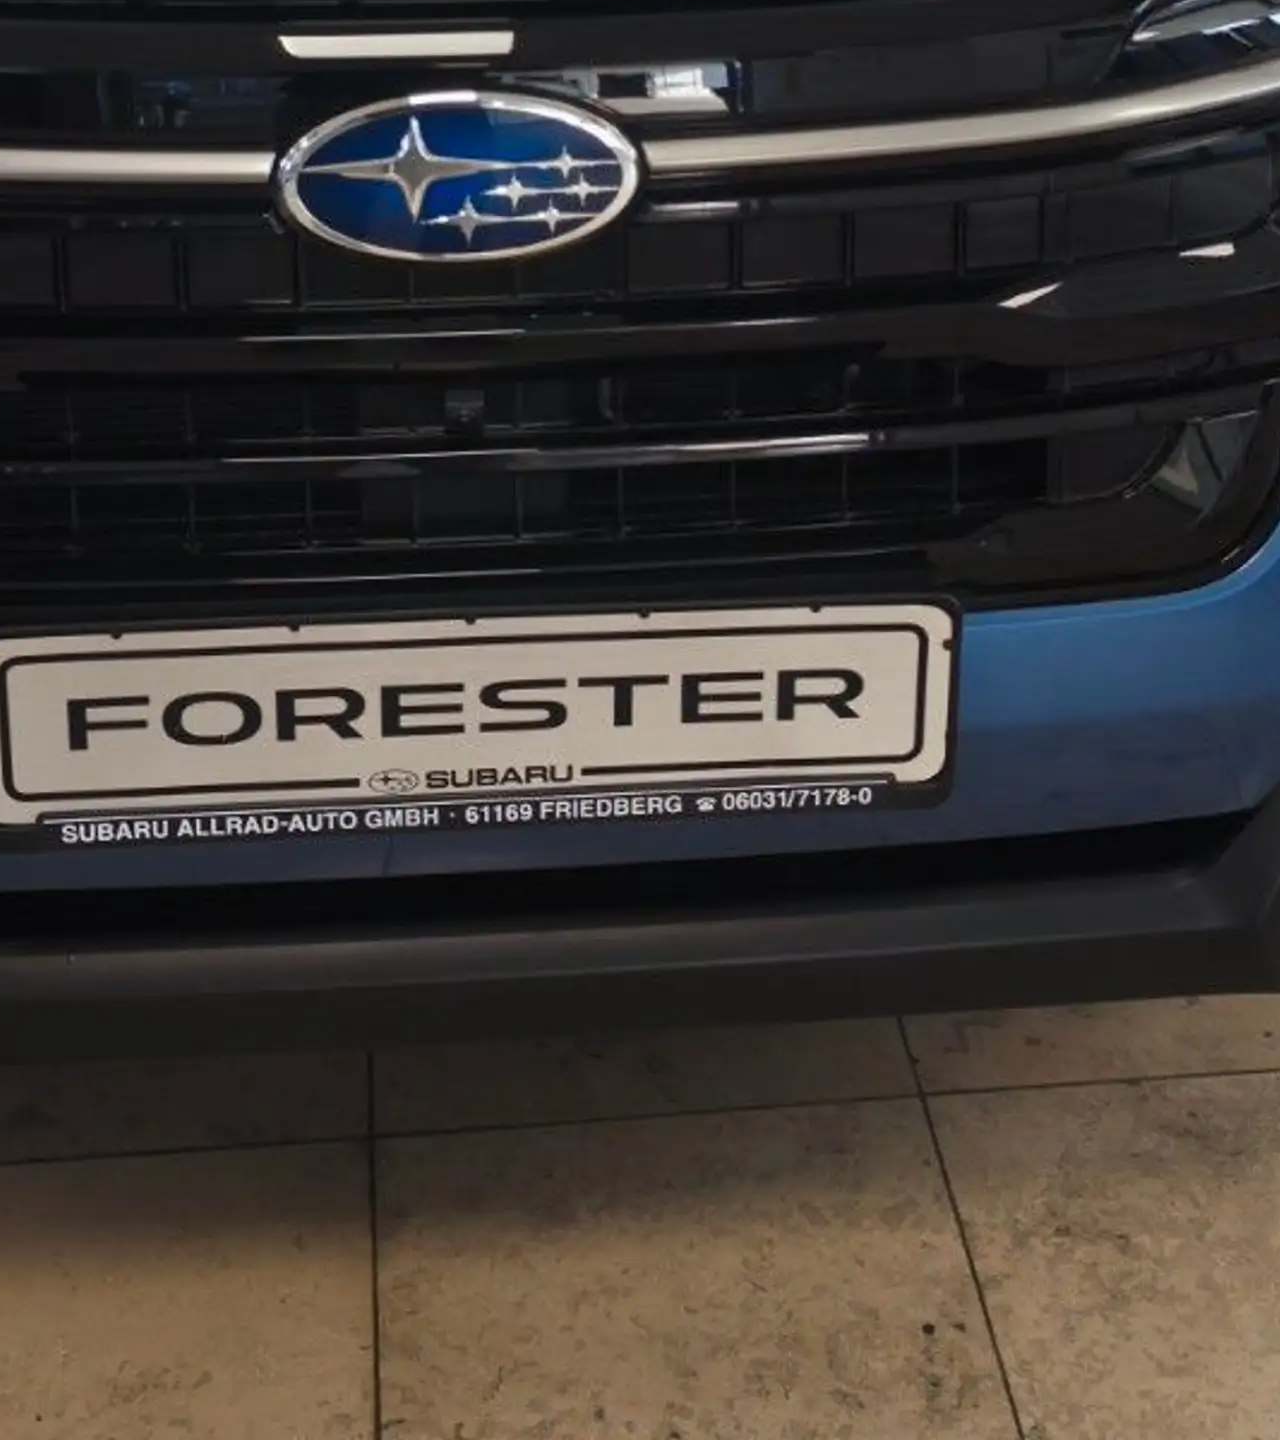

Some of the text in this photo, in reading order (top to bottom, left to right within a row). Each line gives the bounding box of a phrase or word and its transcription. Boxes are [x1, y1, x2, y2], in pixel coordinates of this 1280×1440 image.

[66, 669, 864, 749] FORESTER
[426, 765, 574, 789] SUBARU
[61, 787, 873, 844] SUBARU ALLRAD-AUTO GMBH 61169 FRIEDBERG 06031/7178-0
